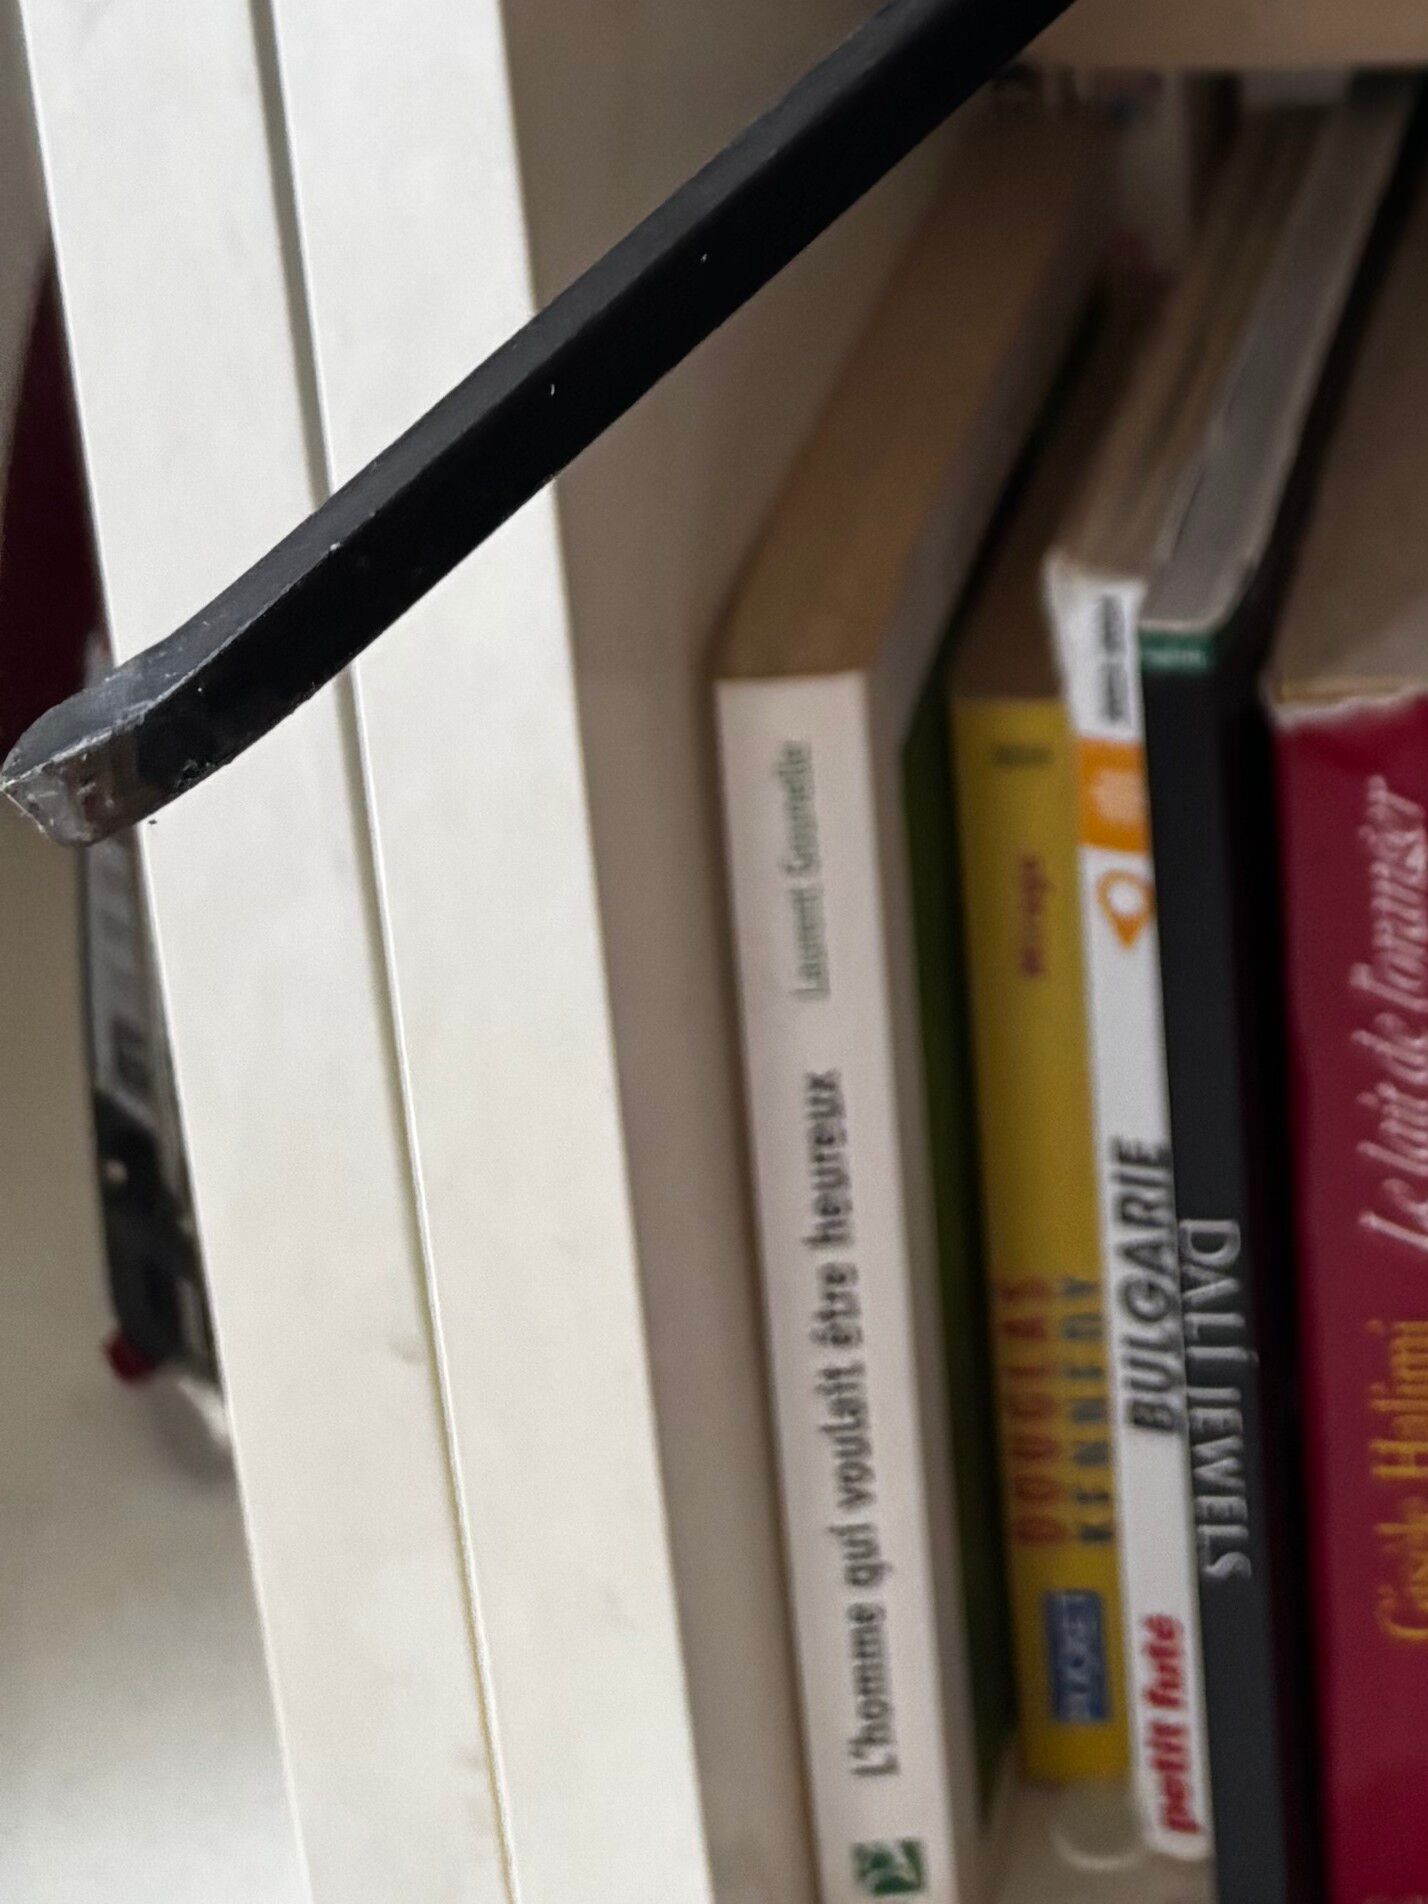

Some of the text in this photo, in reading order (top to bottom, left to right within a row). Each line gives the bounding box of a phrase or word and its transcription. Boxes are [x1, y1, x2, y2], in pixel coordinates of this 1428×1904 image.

[992, 1279, 1060, 1548] DOUGLAS
[1109, 1137, 1183, 1436] BULGARIE
[801, 1070, 901, 1779] L'homme qui voulait être heureux
[1187, 1387, 1252, 1580] JEWELS
[1143, 1614, 1197, 1836] petit futé
